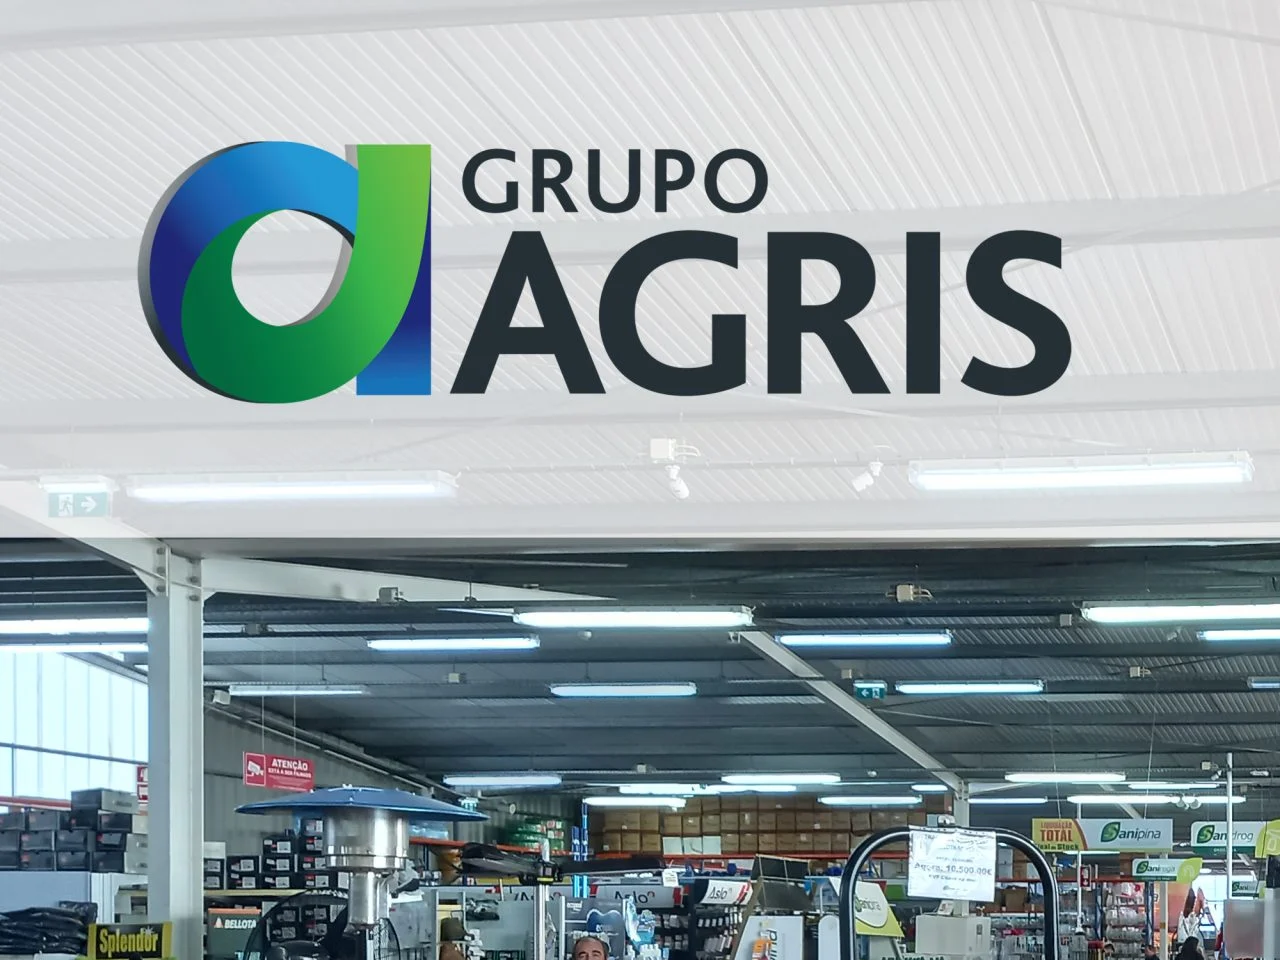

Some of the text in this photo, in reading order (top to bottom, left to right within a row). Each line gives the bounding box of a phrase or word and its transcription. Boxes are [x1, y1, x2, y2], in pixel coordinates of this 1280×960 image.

[271, 757, 309, 772] ATENÇÃO
[1040, 829, 1073, 842] TOTAL
[1101, 821, 1162, 843] Sanipina
[1197, 824, 1254, 844] Sandrog
[708, 886, 728, 899] Aslo
[224, 918, 257, 930] BELLOTA
[100, 927, 159, 958] Splendor
